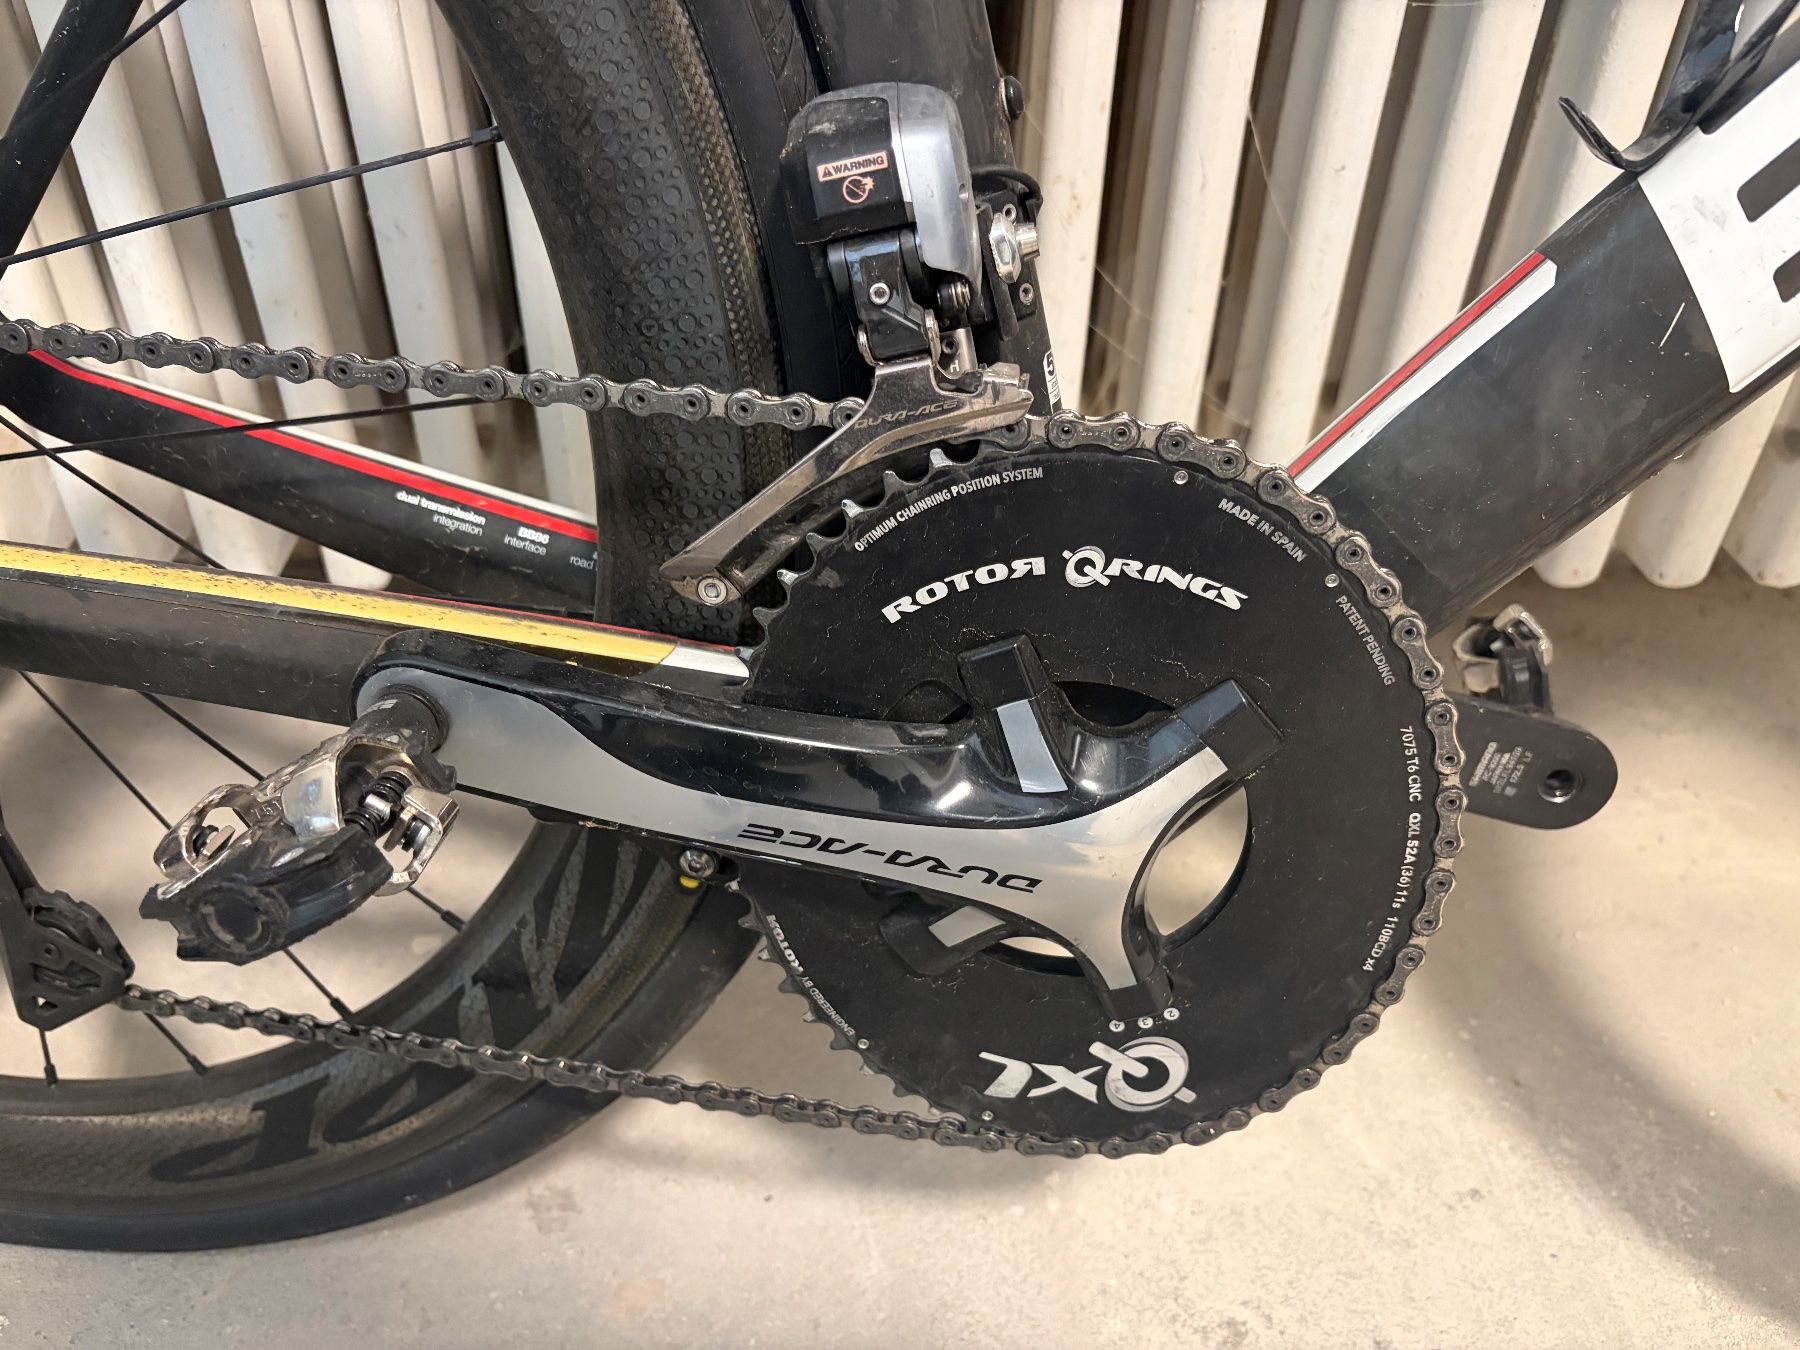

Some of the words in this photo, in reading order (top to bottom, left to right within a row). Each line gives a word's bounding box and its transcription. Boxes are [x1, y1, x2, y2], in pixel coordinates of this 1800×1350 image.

[832, 155, 885, 175] WARNING
[854, 399, 958, 429] DURA-ACE
[396, 490, 420, 506] dual
[420, 497, 486, 526] transmission
[854, 517, 898, 552] OPTIMUM
[896, 489, 951, 522] CHAINRING
[950, 473, 1001, 497] POSITION
[1002, 466, 1044, 484] SYSTEM
[433, 514, 483, 537] integration
[1218, 498, 1258, 527] MADE
[1257, 520, 1275, 536] IN
[1271, 531, 1308, 563] SPAIN
[504, 533, 547, 556] interface
[570, 555, 594, 570] road
[1335, 594, 1371, 637] PATENT
[1362, 633, 1396, 686] PENDING
[1400, 725, 1417, 756] 7075
[1406, 757, 1420, 773] T6
[1408, 775, 1422, 802] CNC
[1408, 812, 1421, 838] QXL
[737, 823, 1043, 894] DURA-ACE
[1403, 840, 1420, 864] 52A
[1397, 865, 1416, 888] (36)
[1391, 889, 1409, 909] 11s
[1370, 916, 1399, 958] 110BCD
[1362, 957, 1376, 972] x4
[801, 976, 814, 988] BY
[809, 987, 856, 1036] ENGINEERED
[978, 1036, 1198, 1112] QXL
